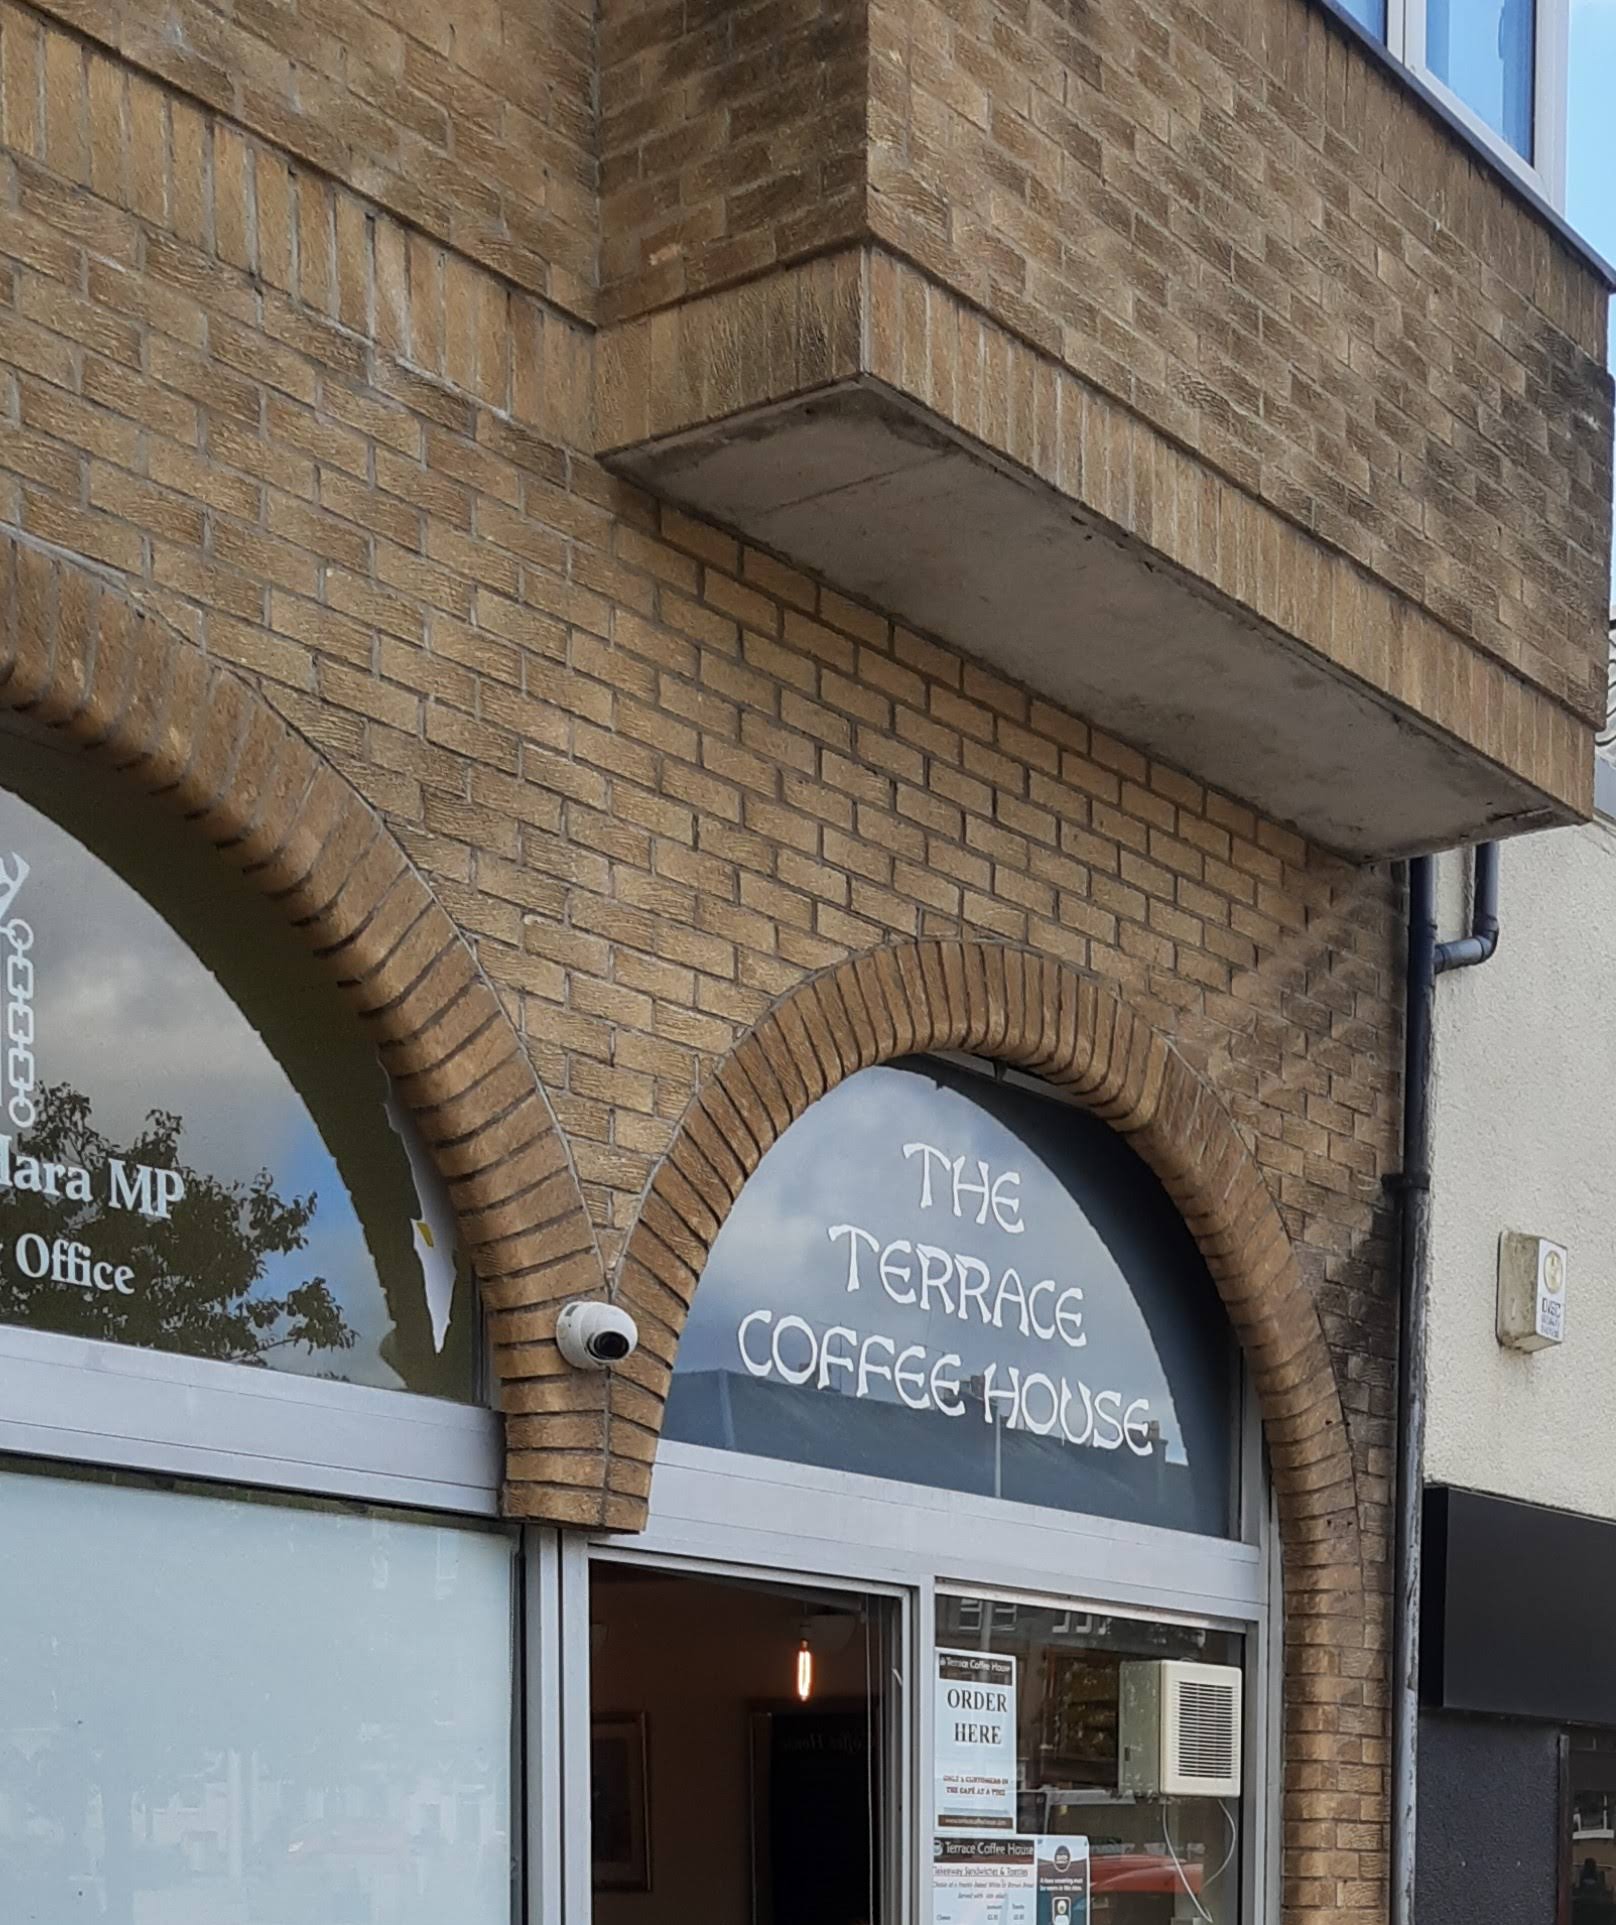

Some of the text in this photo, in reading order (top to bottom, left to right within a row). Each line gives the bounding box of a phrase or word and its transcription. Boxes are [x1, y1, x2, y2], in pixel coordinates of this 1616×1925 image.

[108, 1157, 185, 1220] MP
[903, 1141, 1025, 1234] THE
[15, 1232, 136, 1295] Office
[828, 1223, 1087, 1348] TERRACE
[737, 1309, 1153, 1457] COFFEE HOUSE
[947, 1688, 1008, 1713] ORDER
[955, 1722, 1002, 1745] HERE
[945, 1841, 1034, 1857] Terrace Coffee House
